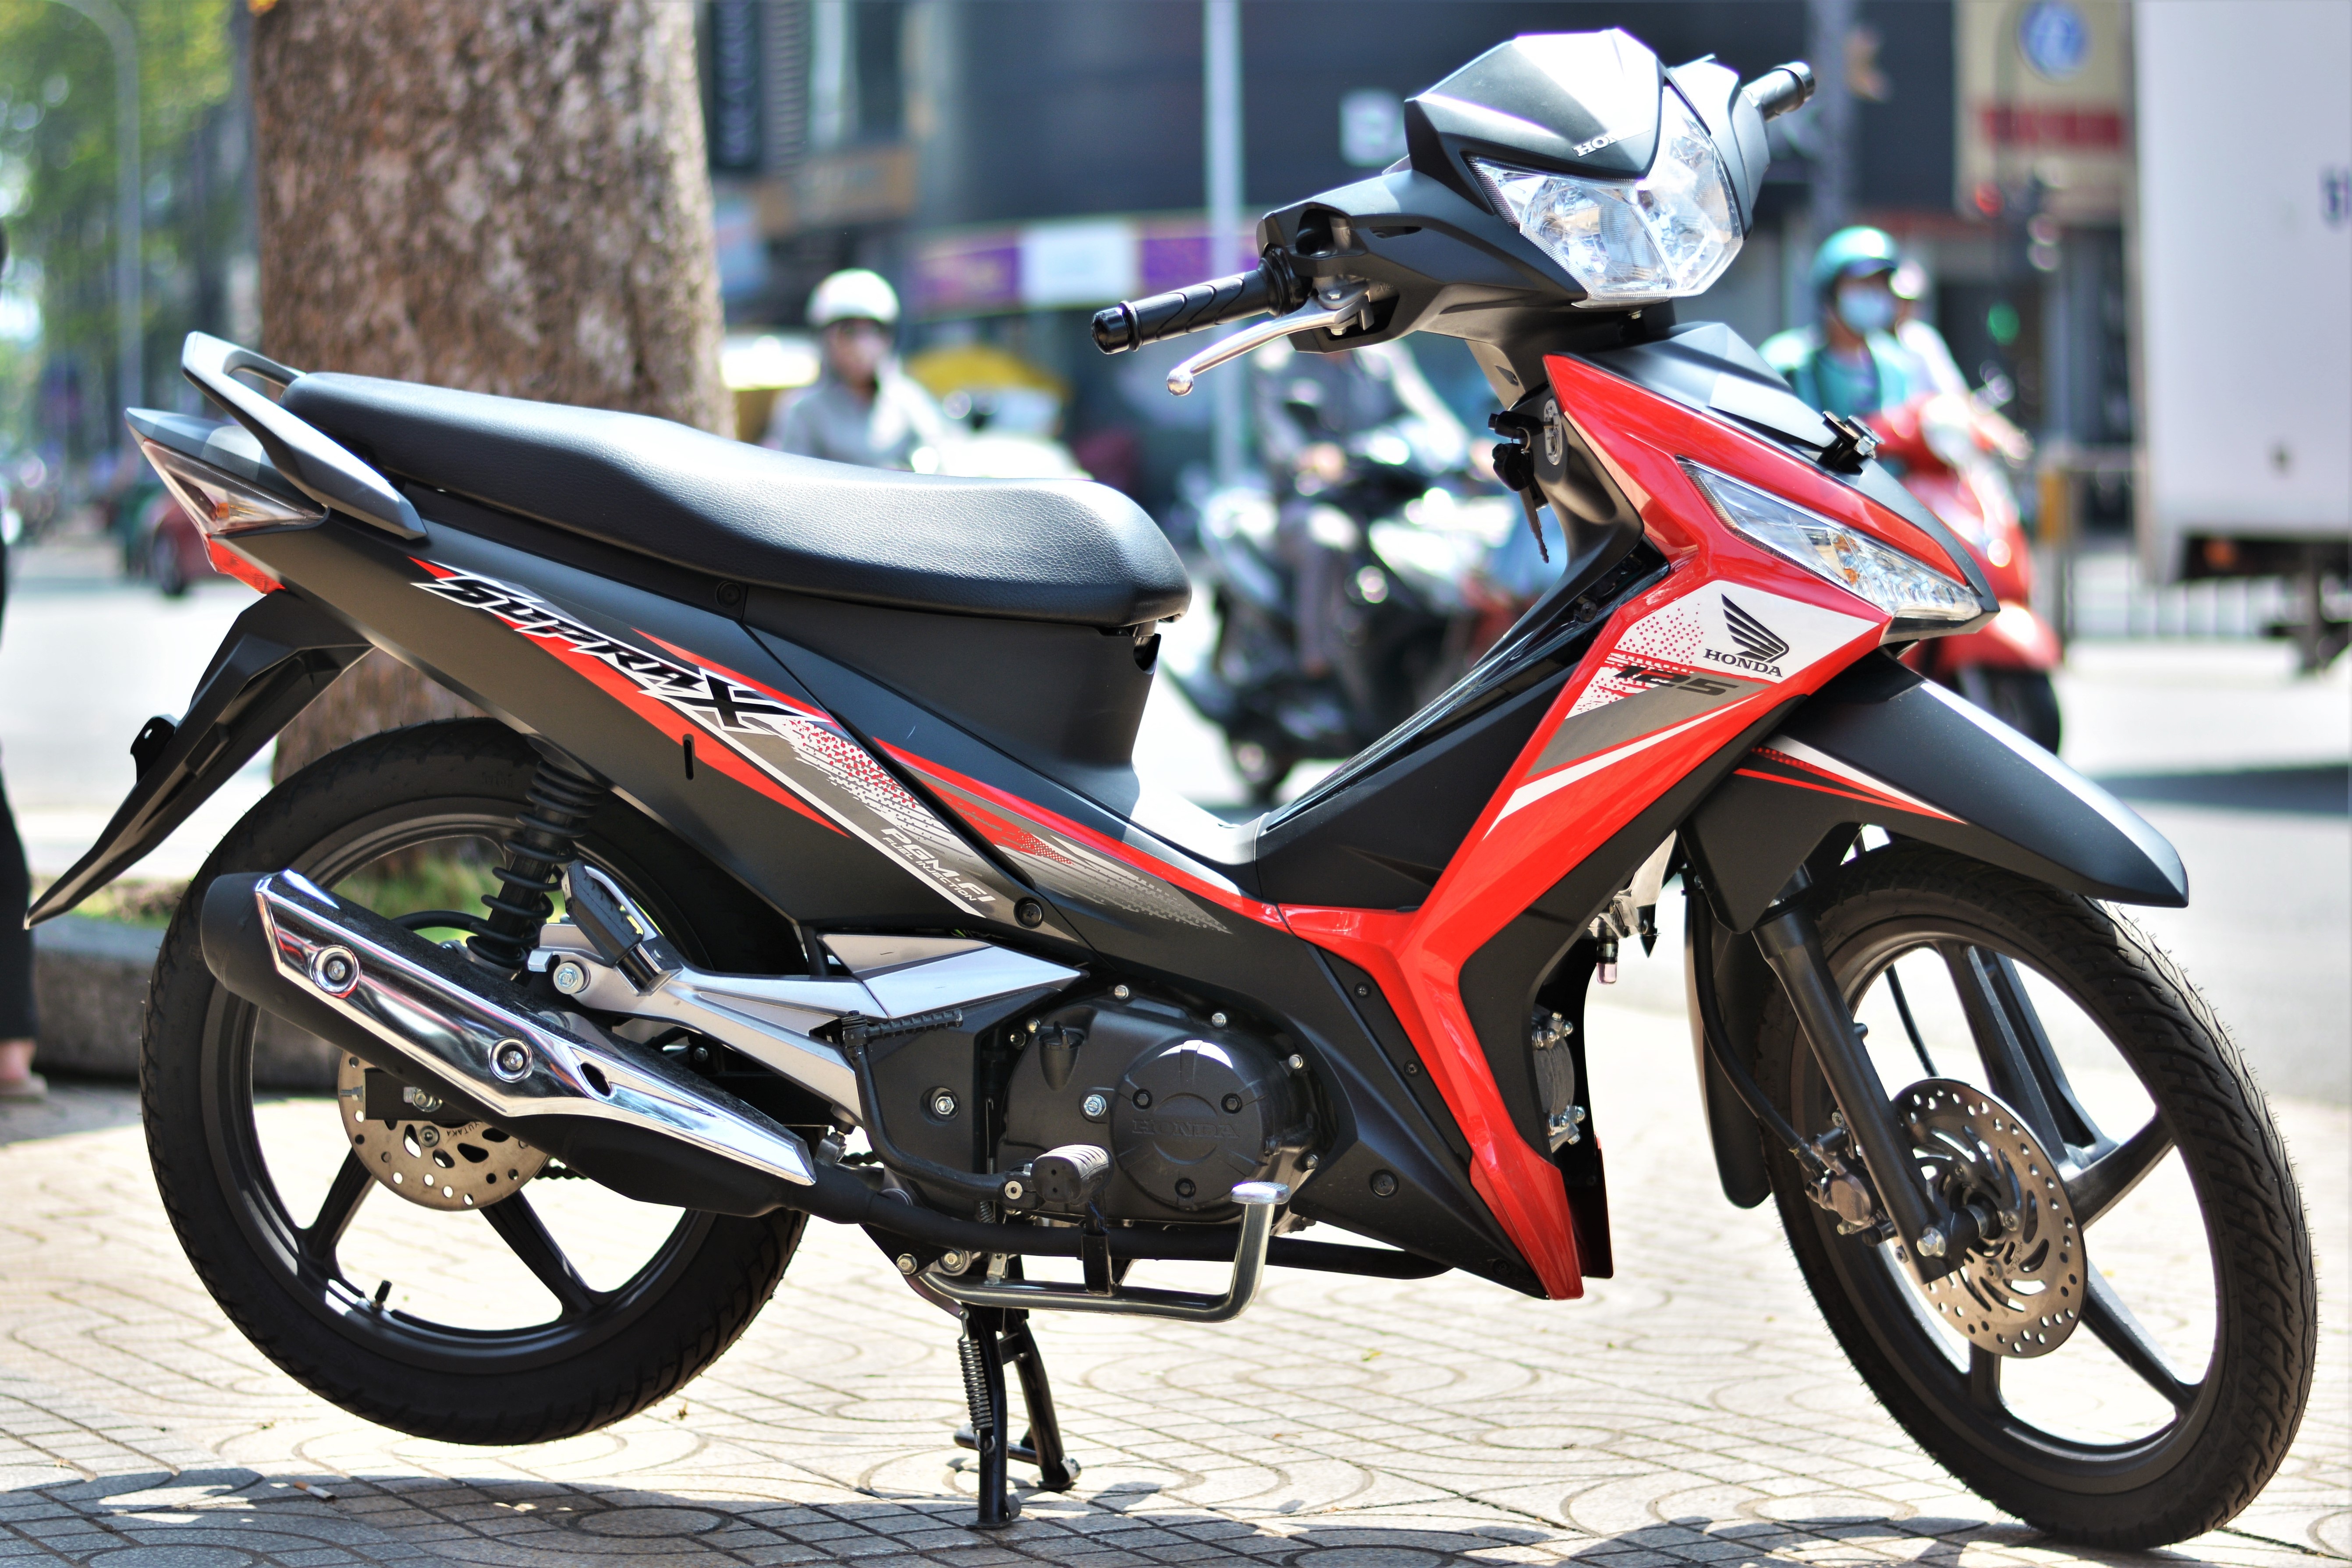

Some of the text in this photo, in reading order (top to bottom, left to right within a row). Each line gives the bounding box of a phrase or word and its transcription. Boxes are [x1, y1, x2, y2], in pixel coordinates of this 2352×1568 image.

[1703, 648, 1783, 678] HONDA
[1613, 665, 1739, 695] 125
[881, 828, 996, 902] PGM-FI
[882, 837, 977, 901] FUEL INJECTION
[446, 1121, 480, 1137] YUTAKA
[1132, 1118, 1240, 1139] HONDA
